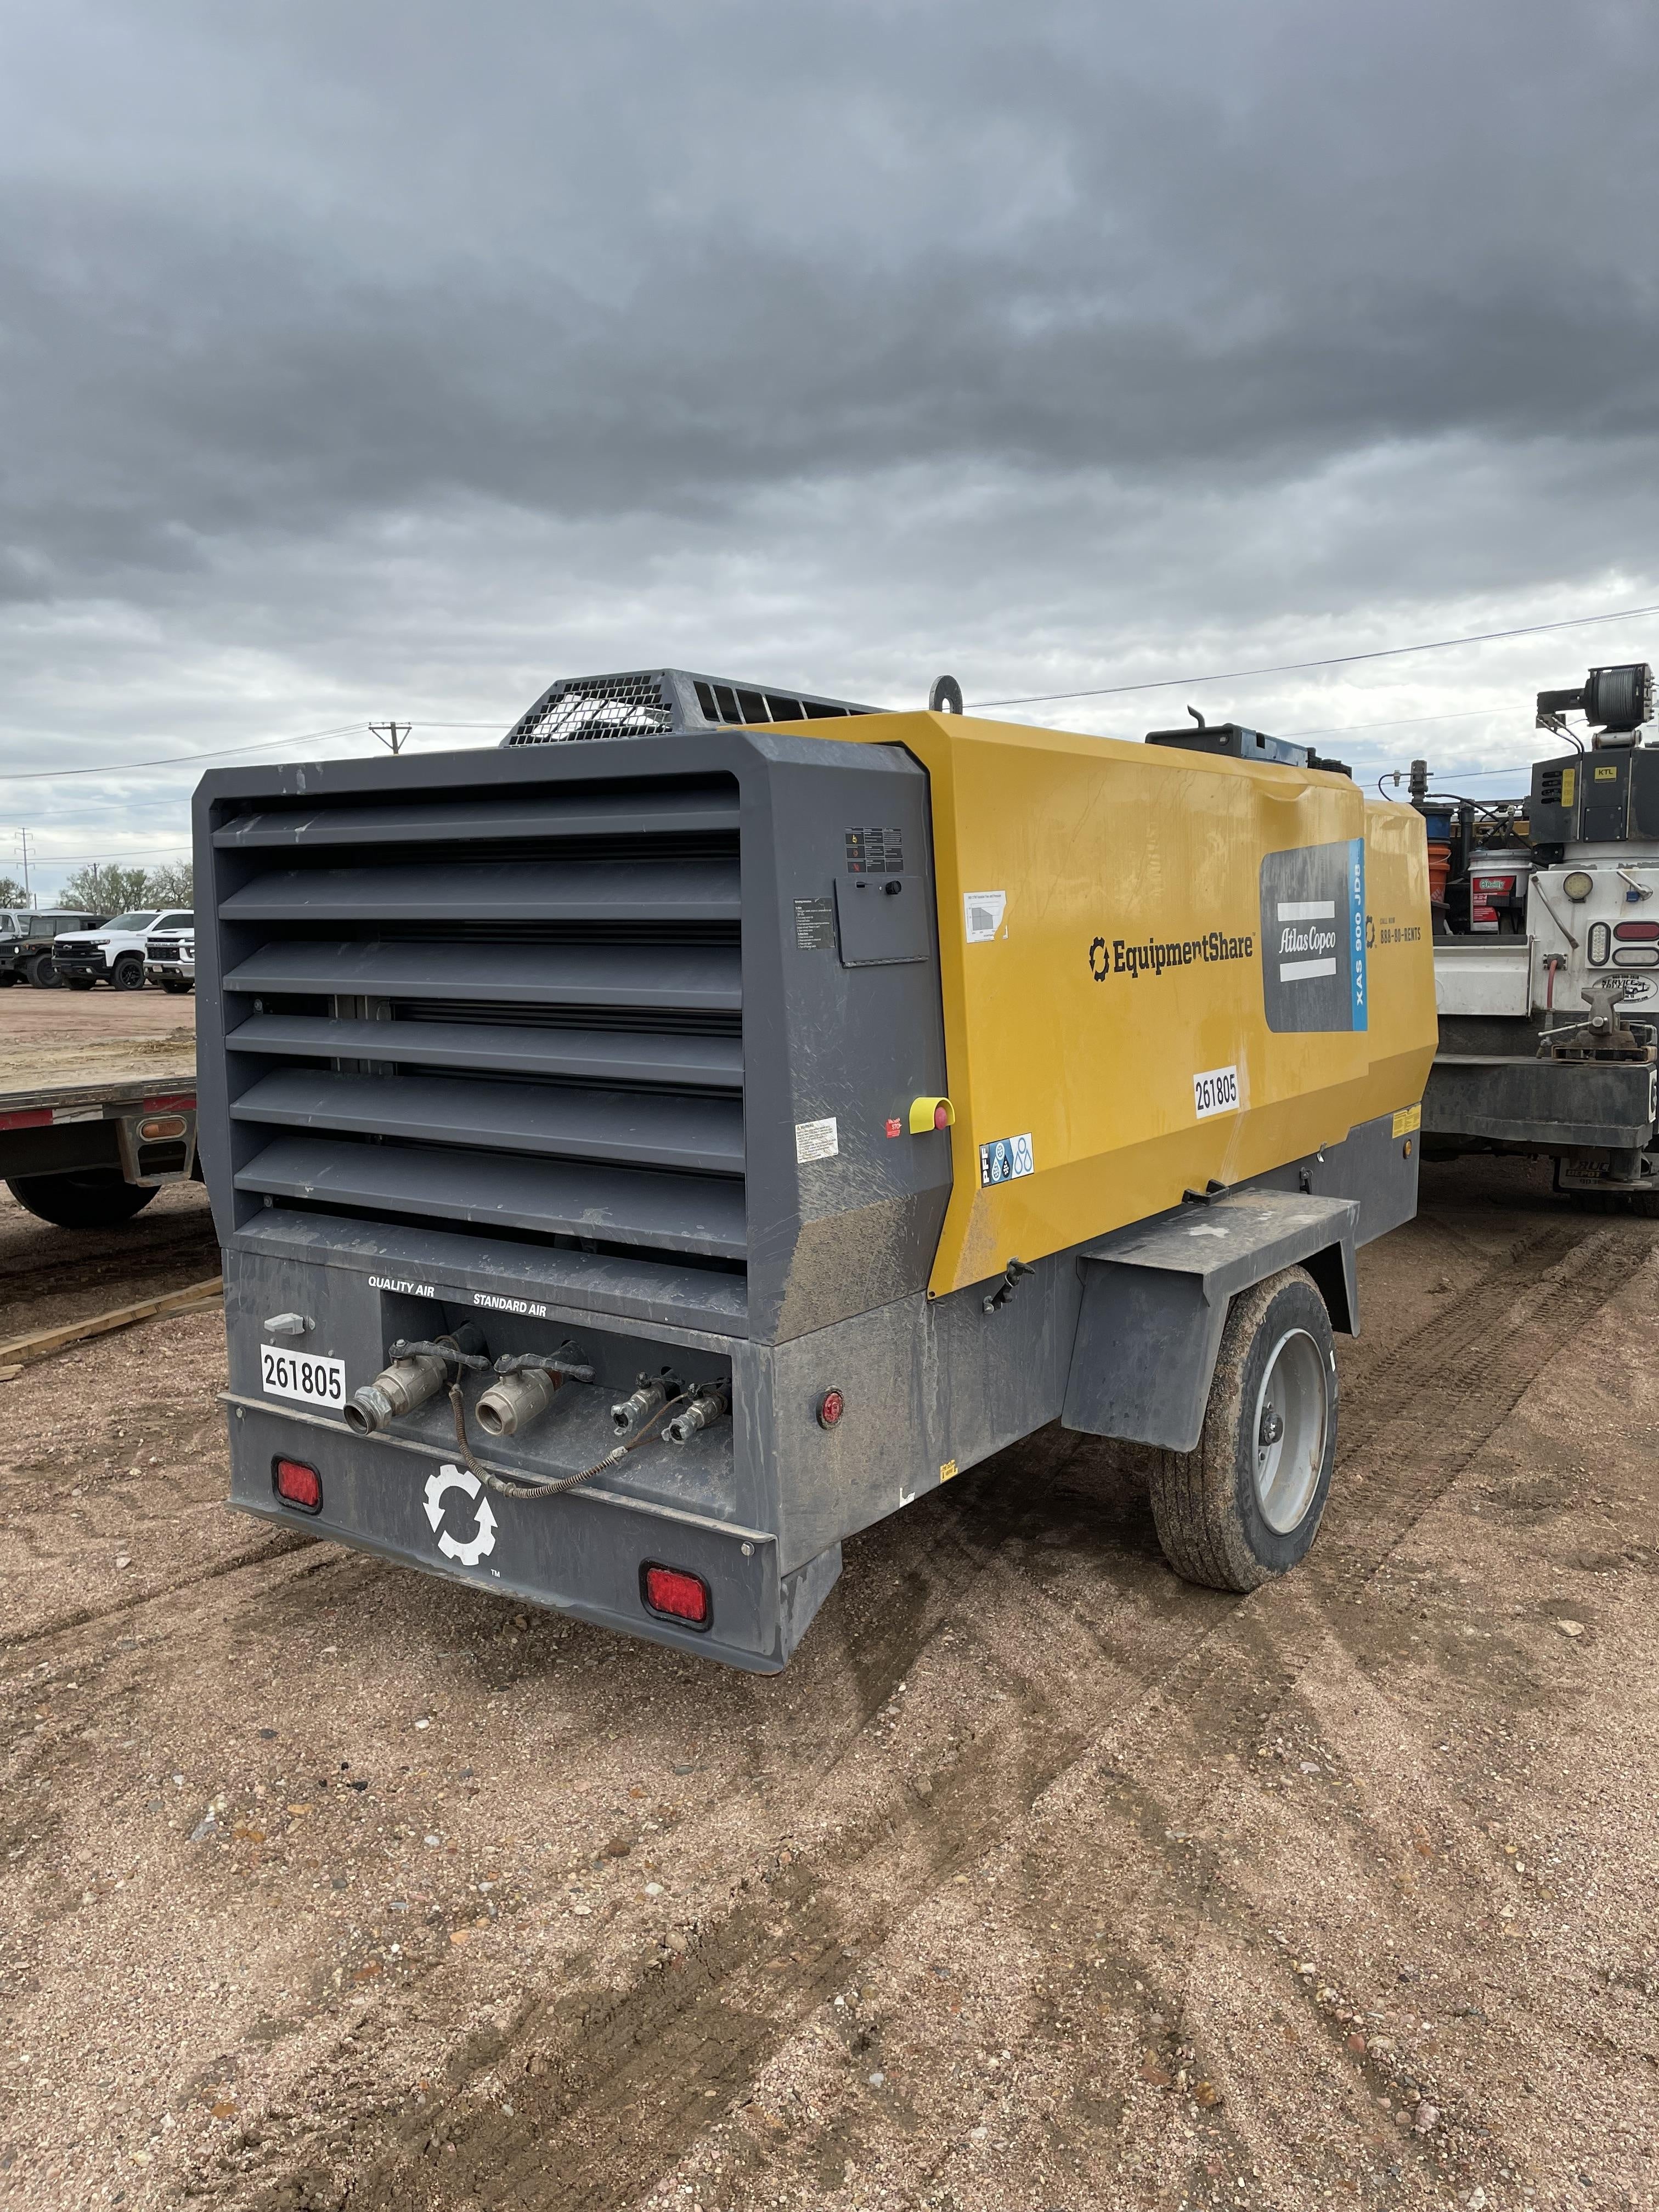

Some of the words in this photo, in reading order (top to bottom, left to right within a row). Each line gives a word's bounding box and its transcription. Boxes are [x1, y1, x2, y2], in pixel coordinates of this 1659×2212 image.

[1481, 880, 1504, 889] O'Reilly
[1279, 926, 1308, 954] Atlas
[1309, 926, 1336, 955] Copco
[1380, 927, 1421, 944] 888-80-RENTS
[1113, 932, 1252, 978] EquipmentShare
[1196, 1074, 1237, 1111] 261805
[981, 1147, 990, 1184] PFF
[368, 1276, 414, 1293] QUALITY
[415, 1284, 434, 1297] AIR
[473, 1293, 527, 1313] STANDARD
[528, 1304, 546, 1317] AIR
[264, 1354, 341, 1400] 261805
